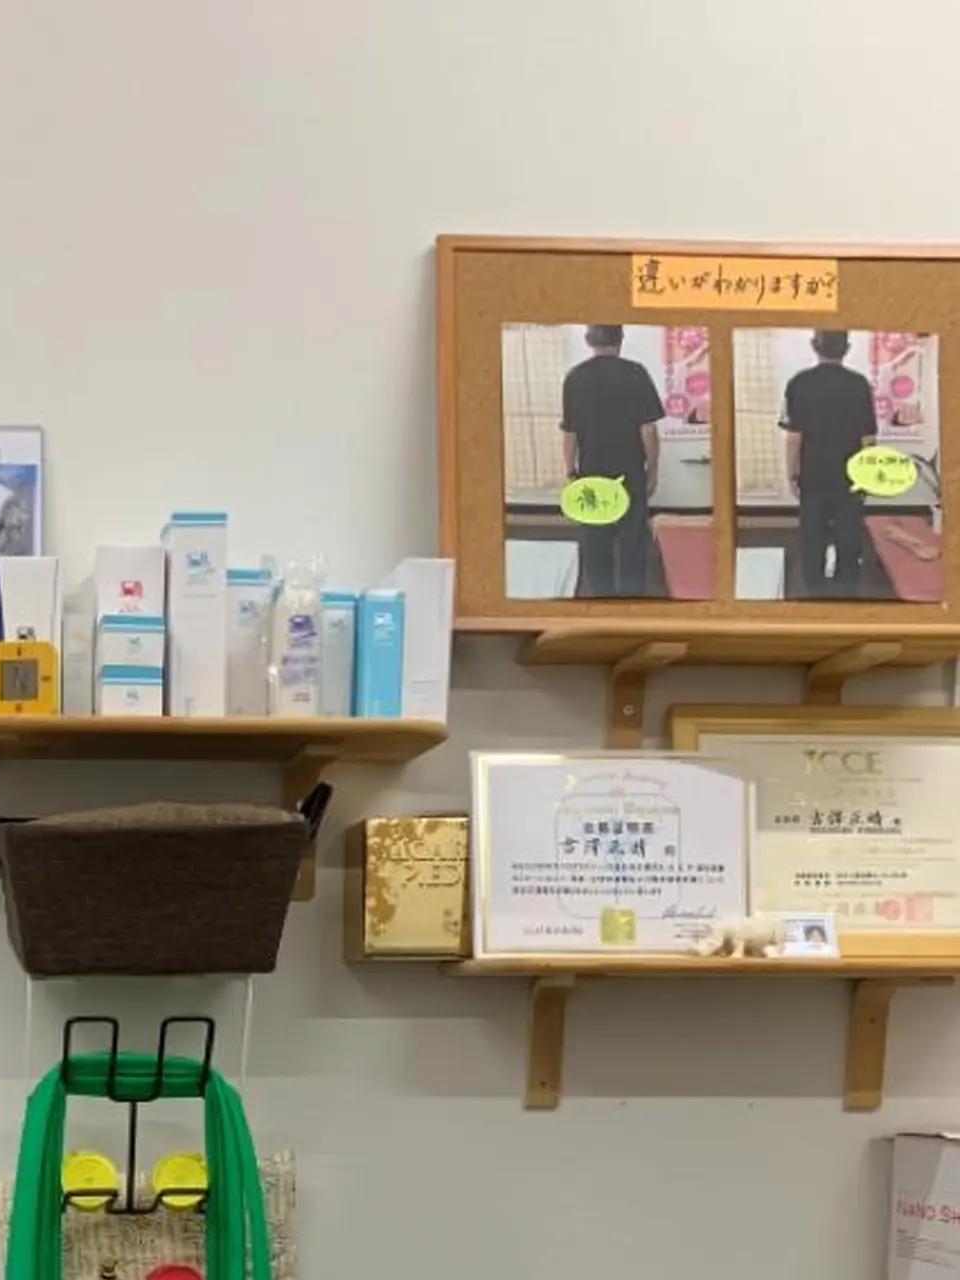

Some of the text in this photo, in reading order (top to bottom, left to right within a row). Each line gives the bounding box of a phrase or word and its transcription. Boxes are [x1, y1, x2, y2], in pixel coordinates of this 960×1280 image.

[637, 259, 839, 304] 違いがわかりますか?
